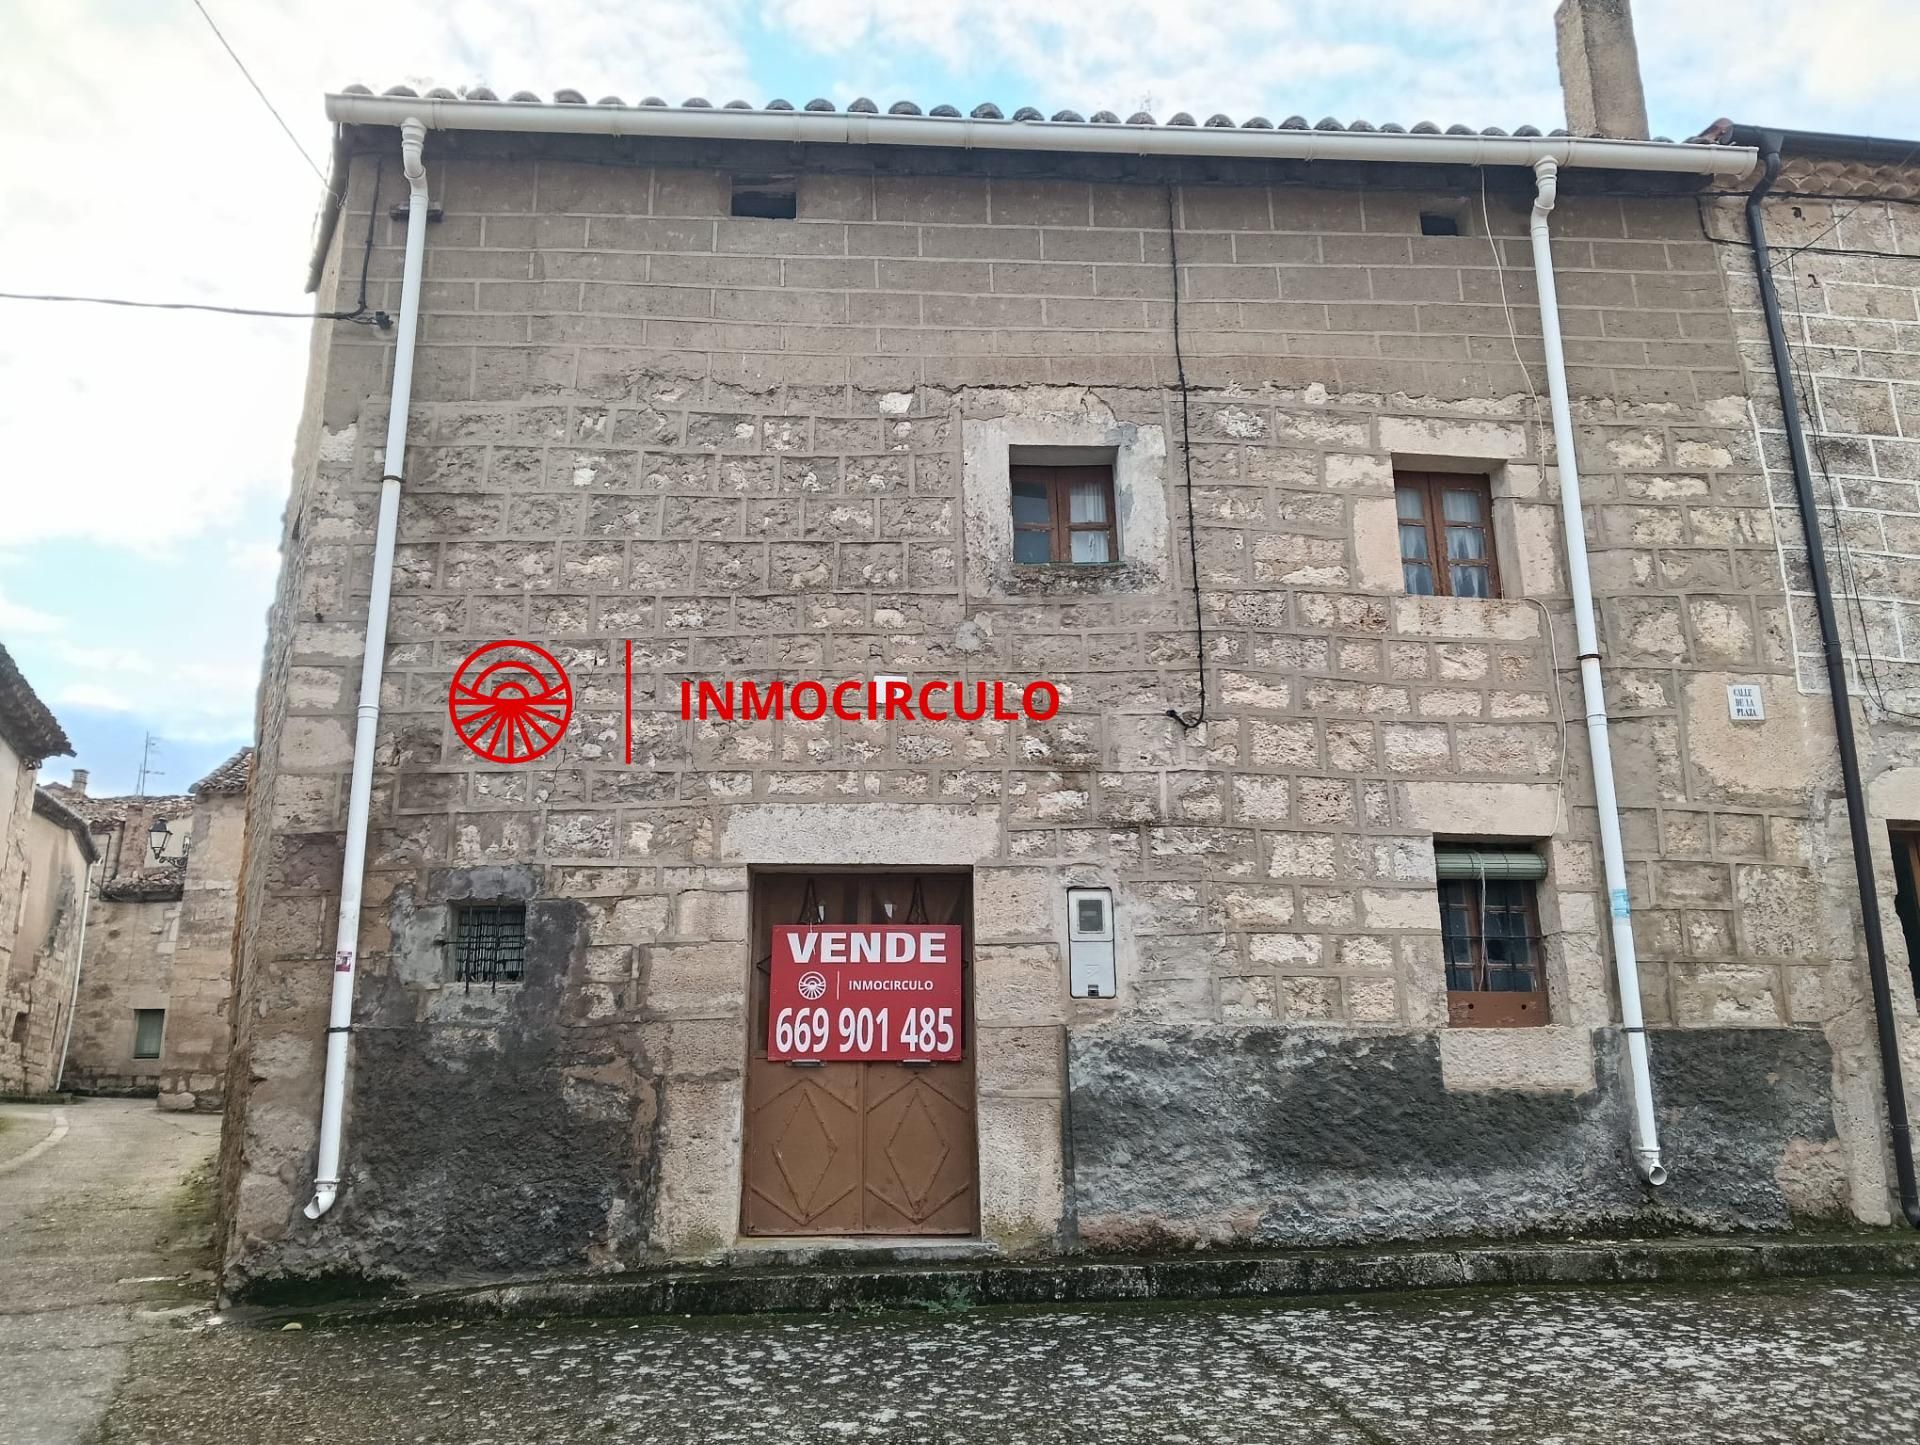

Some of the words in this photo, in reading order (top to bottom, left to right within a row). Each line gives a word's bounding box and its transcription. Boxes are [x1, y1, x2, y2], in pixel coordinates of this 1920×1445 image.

[1733, 688, 1752, 697] CALLE
[1735, 698, 1744, 707] DE
[1746, 698, 1755, 707] LA
[1736, 708, 1757, 717] PLAZA
[787, 932, 947, 964] VENDE
[849, 980, 934, 991] INMOCIRCULO
[776, 1007, 829, 1053] 669
[838, 1007, 889, 1053] 901
[900, 1007, 954, 1053] 485
